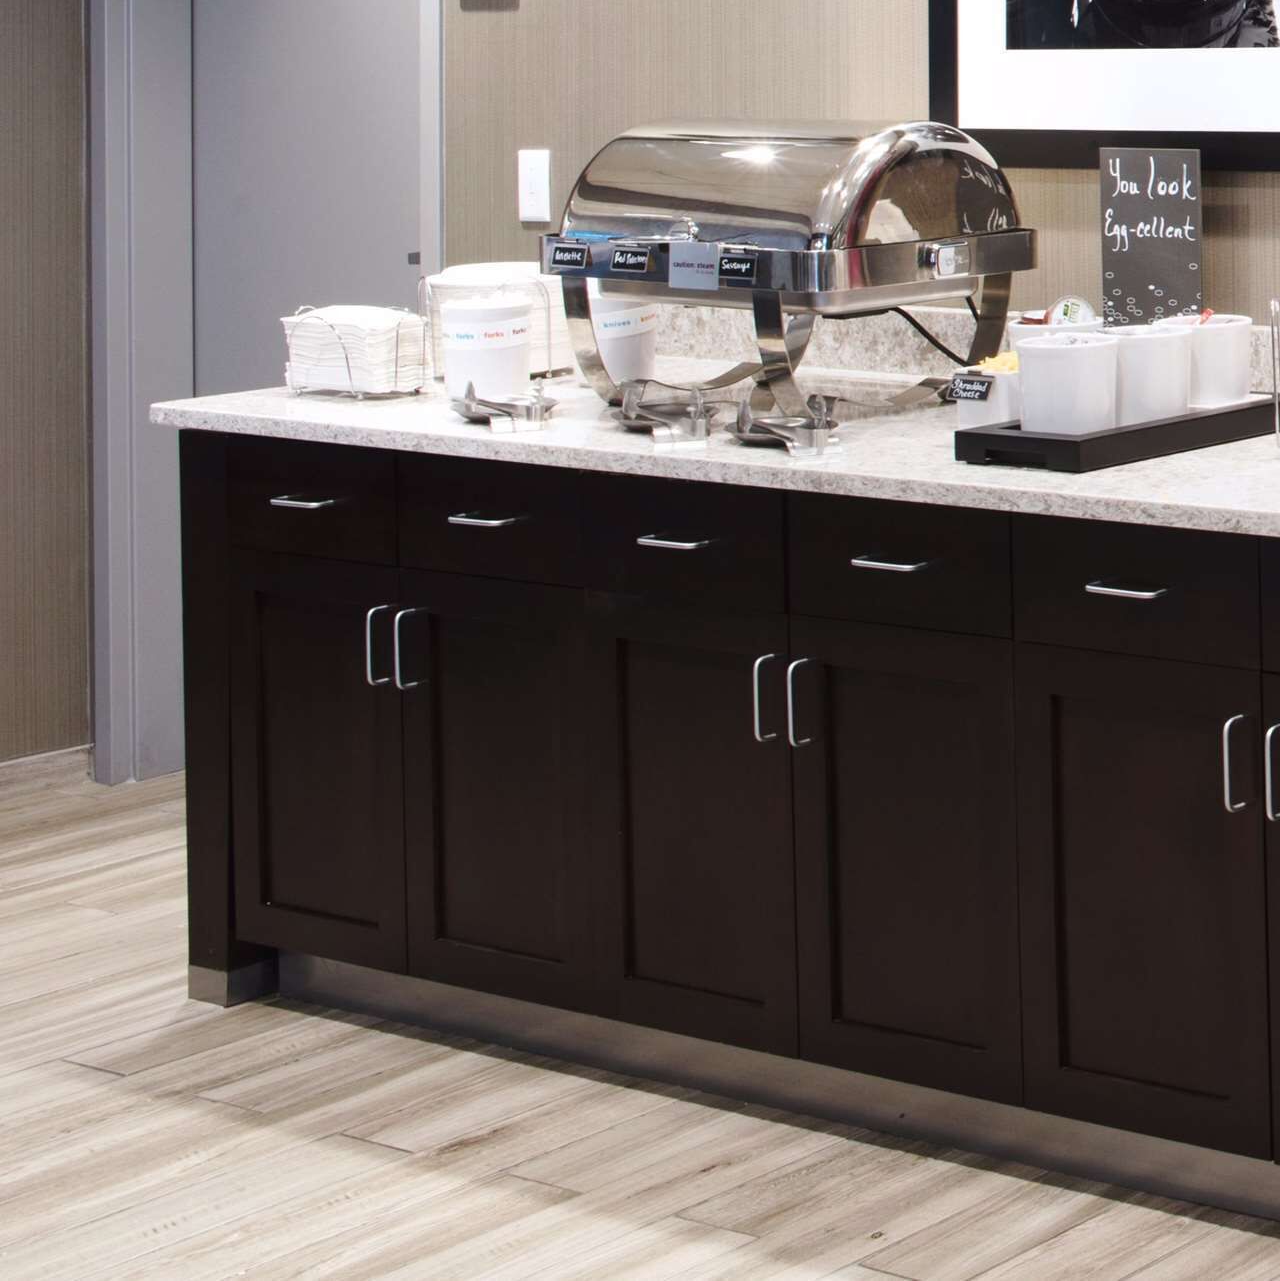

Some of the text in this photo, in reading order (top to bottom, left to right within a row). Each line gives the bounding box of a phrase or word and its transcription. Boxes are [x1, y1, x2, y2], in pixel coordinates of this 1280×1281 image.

[1108, 155, 1197, 200] You look
[1104, 208, 1197, 252] Egg-cellent
